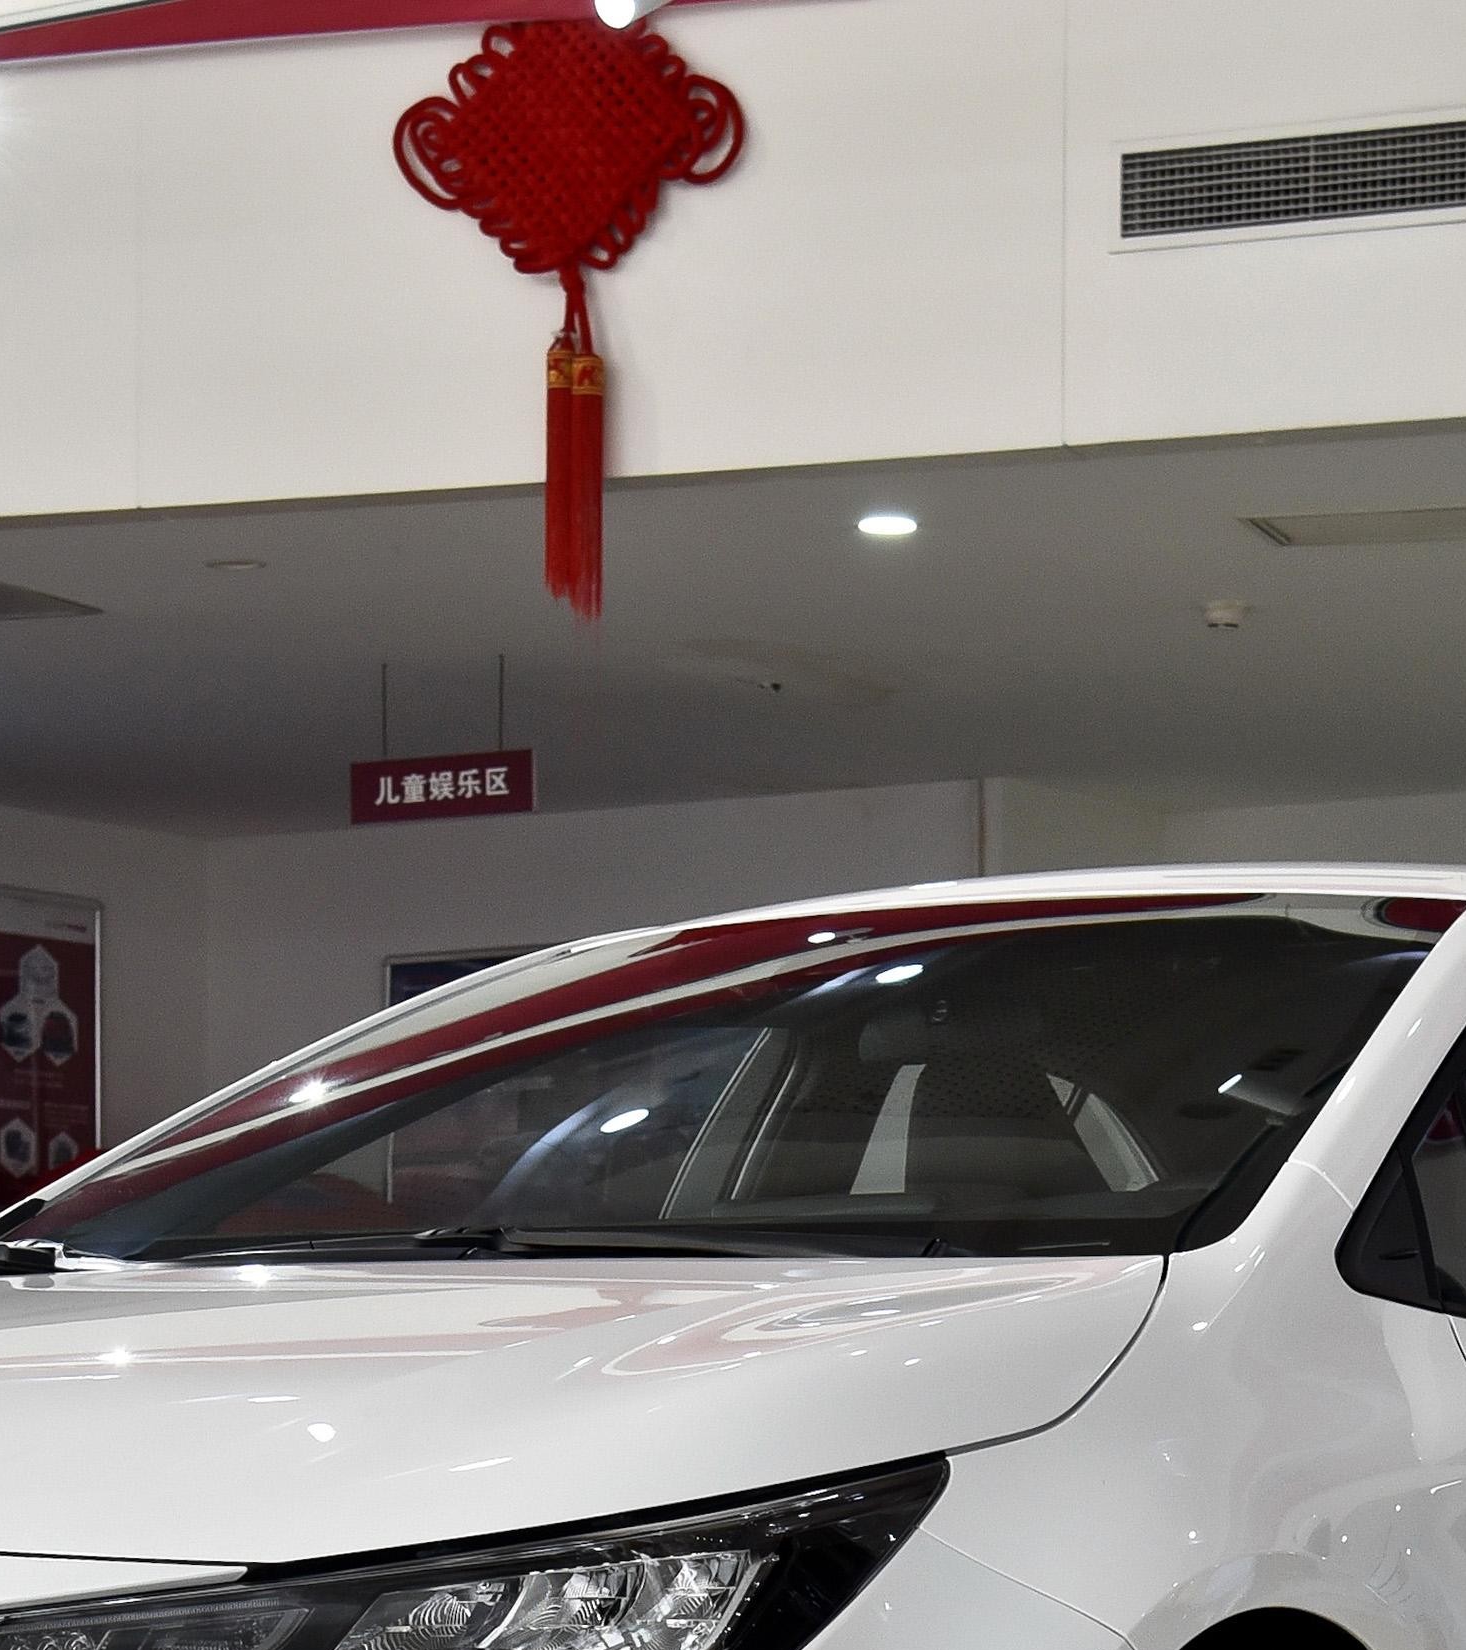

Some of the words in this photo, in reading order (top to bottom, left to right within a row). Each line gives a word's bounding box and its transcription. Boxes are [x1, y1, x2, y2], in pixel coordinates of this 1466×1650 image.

[374, 766, 510, 806] 儿童娱乐区
